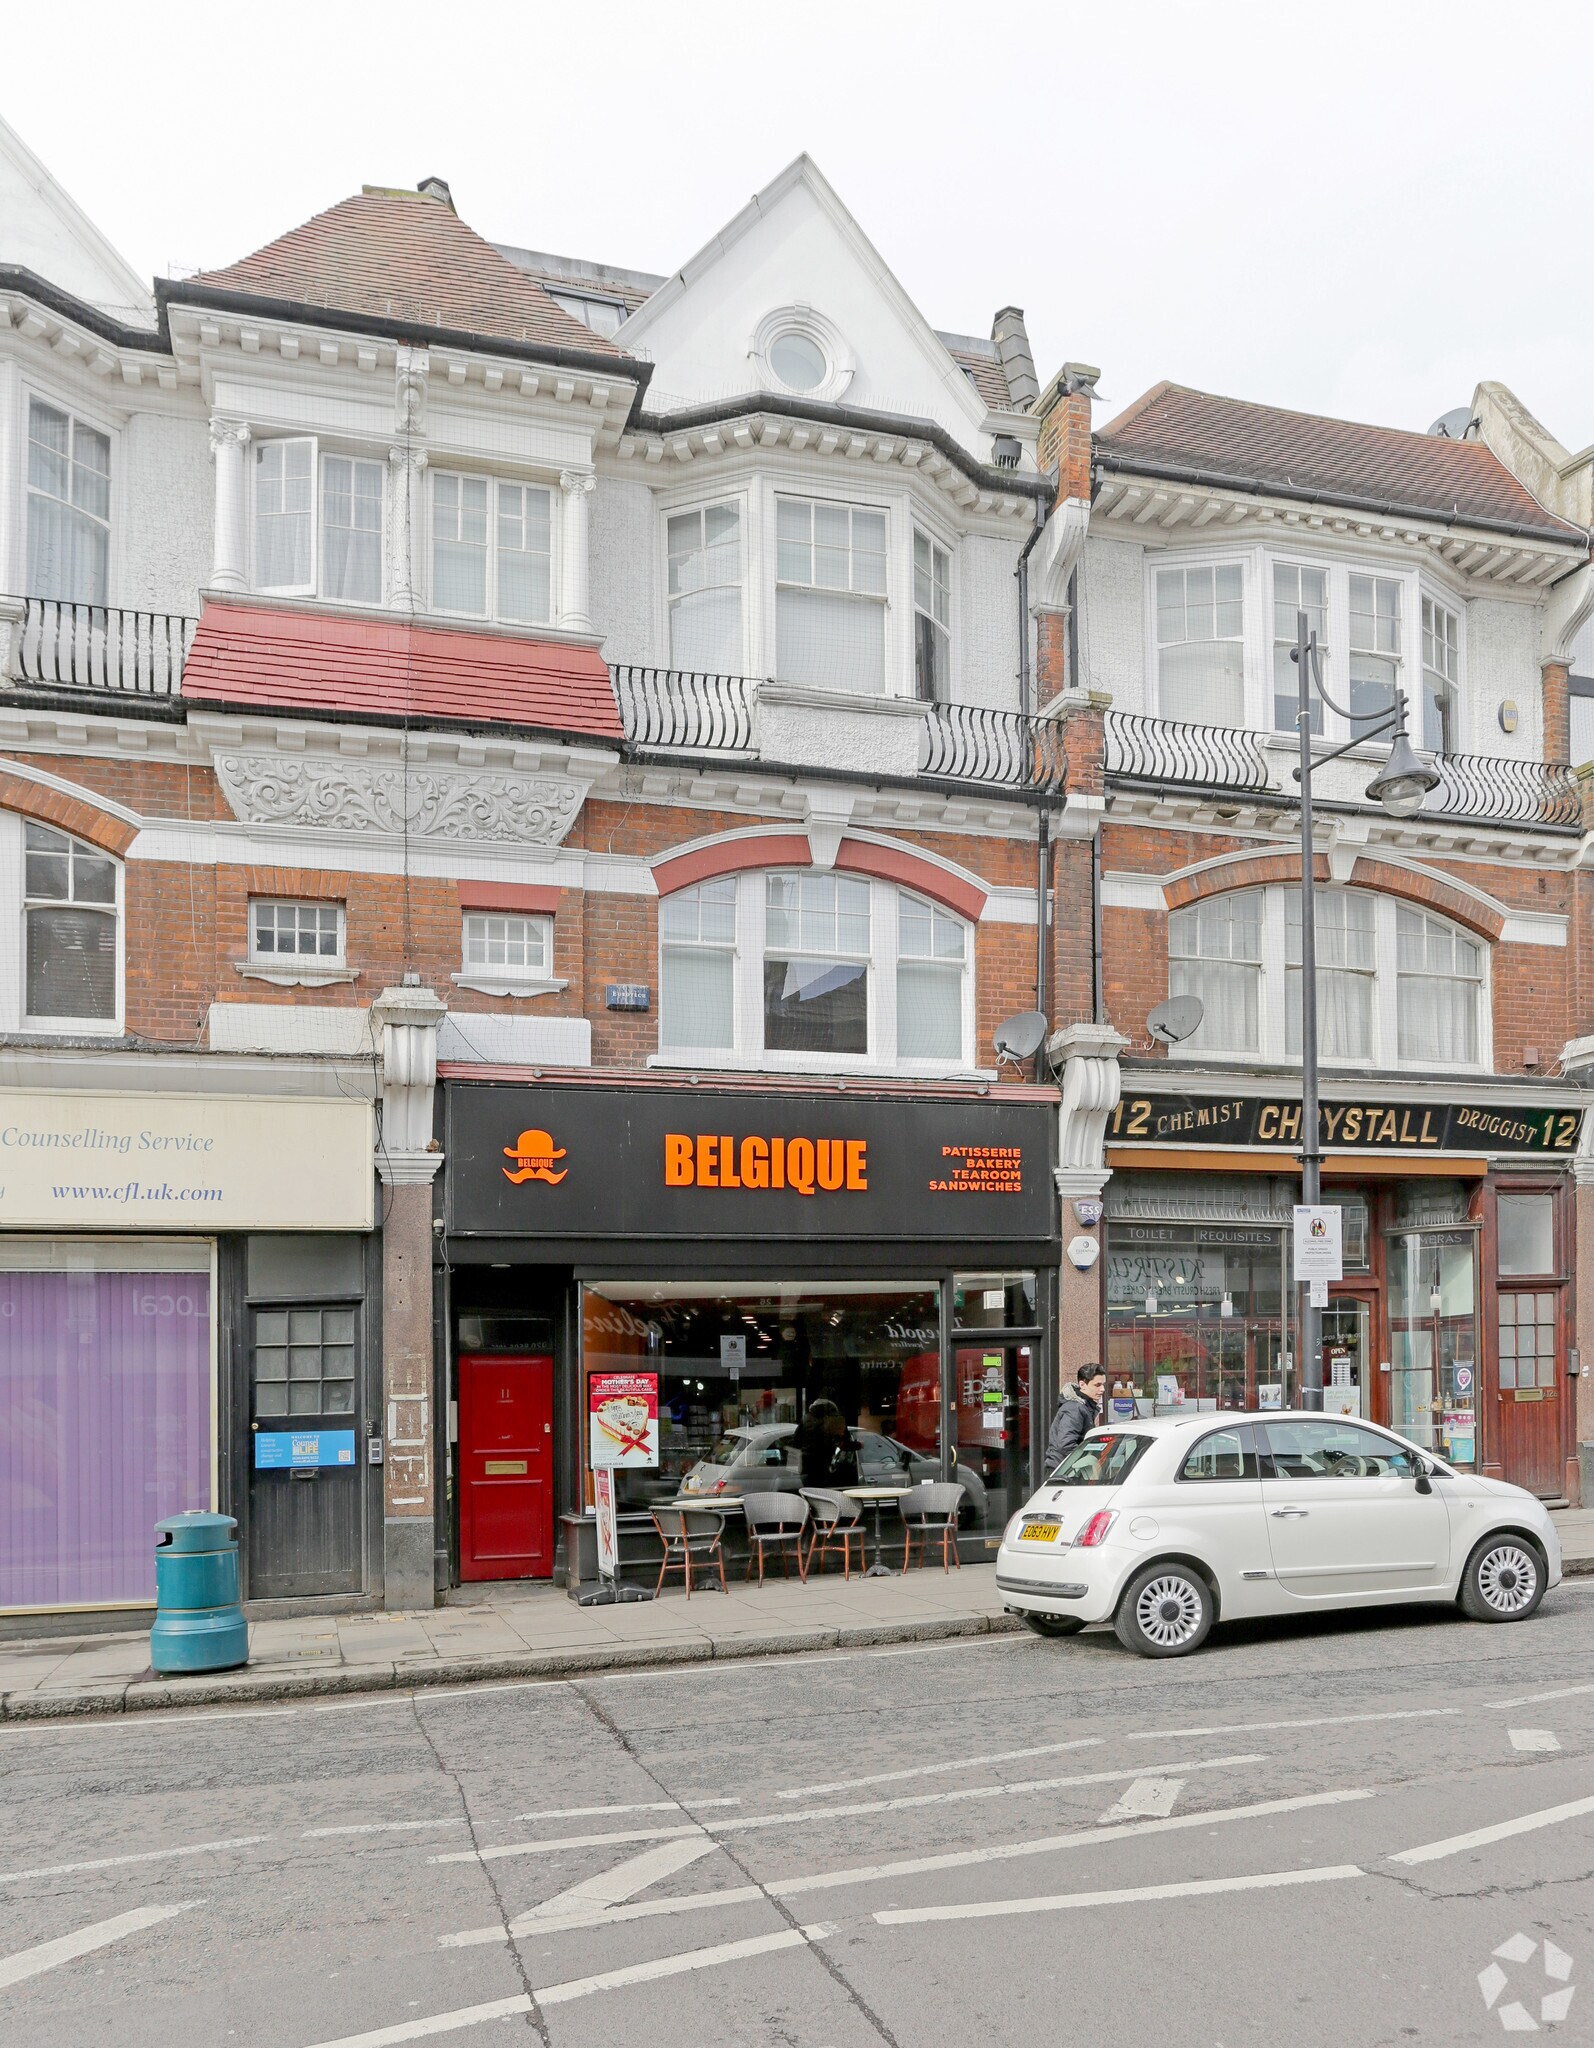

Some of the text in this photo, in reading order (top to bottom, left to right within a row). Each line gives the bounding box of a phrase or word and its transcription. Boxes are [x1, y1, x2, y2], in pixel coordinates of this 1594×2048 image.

[1112, 1100, 1151, 1134] 12
[1157, 1101, 1244, 1133] CHEMIST
[1258, 1105, 1438, 1143] CHYSTALL
[1457, 1108, 1538, 1144] DRUGGIST
[1543, 1114, 1577, 1147] 12
[1, 1127, 214, 1154] Counselling Service
[942, 1146, 1021, 1158] PATISSERIE
[517, 1158, 554, 1168] BELGIQUE
[665, 1134, 868, 1195] BELGIQUE
[966, 1158, 1021, 1169] BAKERY
[952, 1169, 1021, 1180] TEAROOM
[928, 1180, 1022, 1192] SANDWICHES
[51, 1182, 224, 1203] www.cfl.uk.com
[1081, 1206, 1100, 1215] ESS
[1127, 1227, 1176, 1240] TOILET
[1199, 1230, 1272, 1242] REQUISITES
[1331, 1347, 1346, 1355] OPEN
[501, 1388, 510, 1399] 11
[292, 1439, 319, 1447] Counsel
[300, 1446, 319, 1454] LIFE
[1041, 1526, 1059, 1539] HVY
